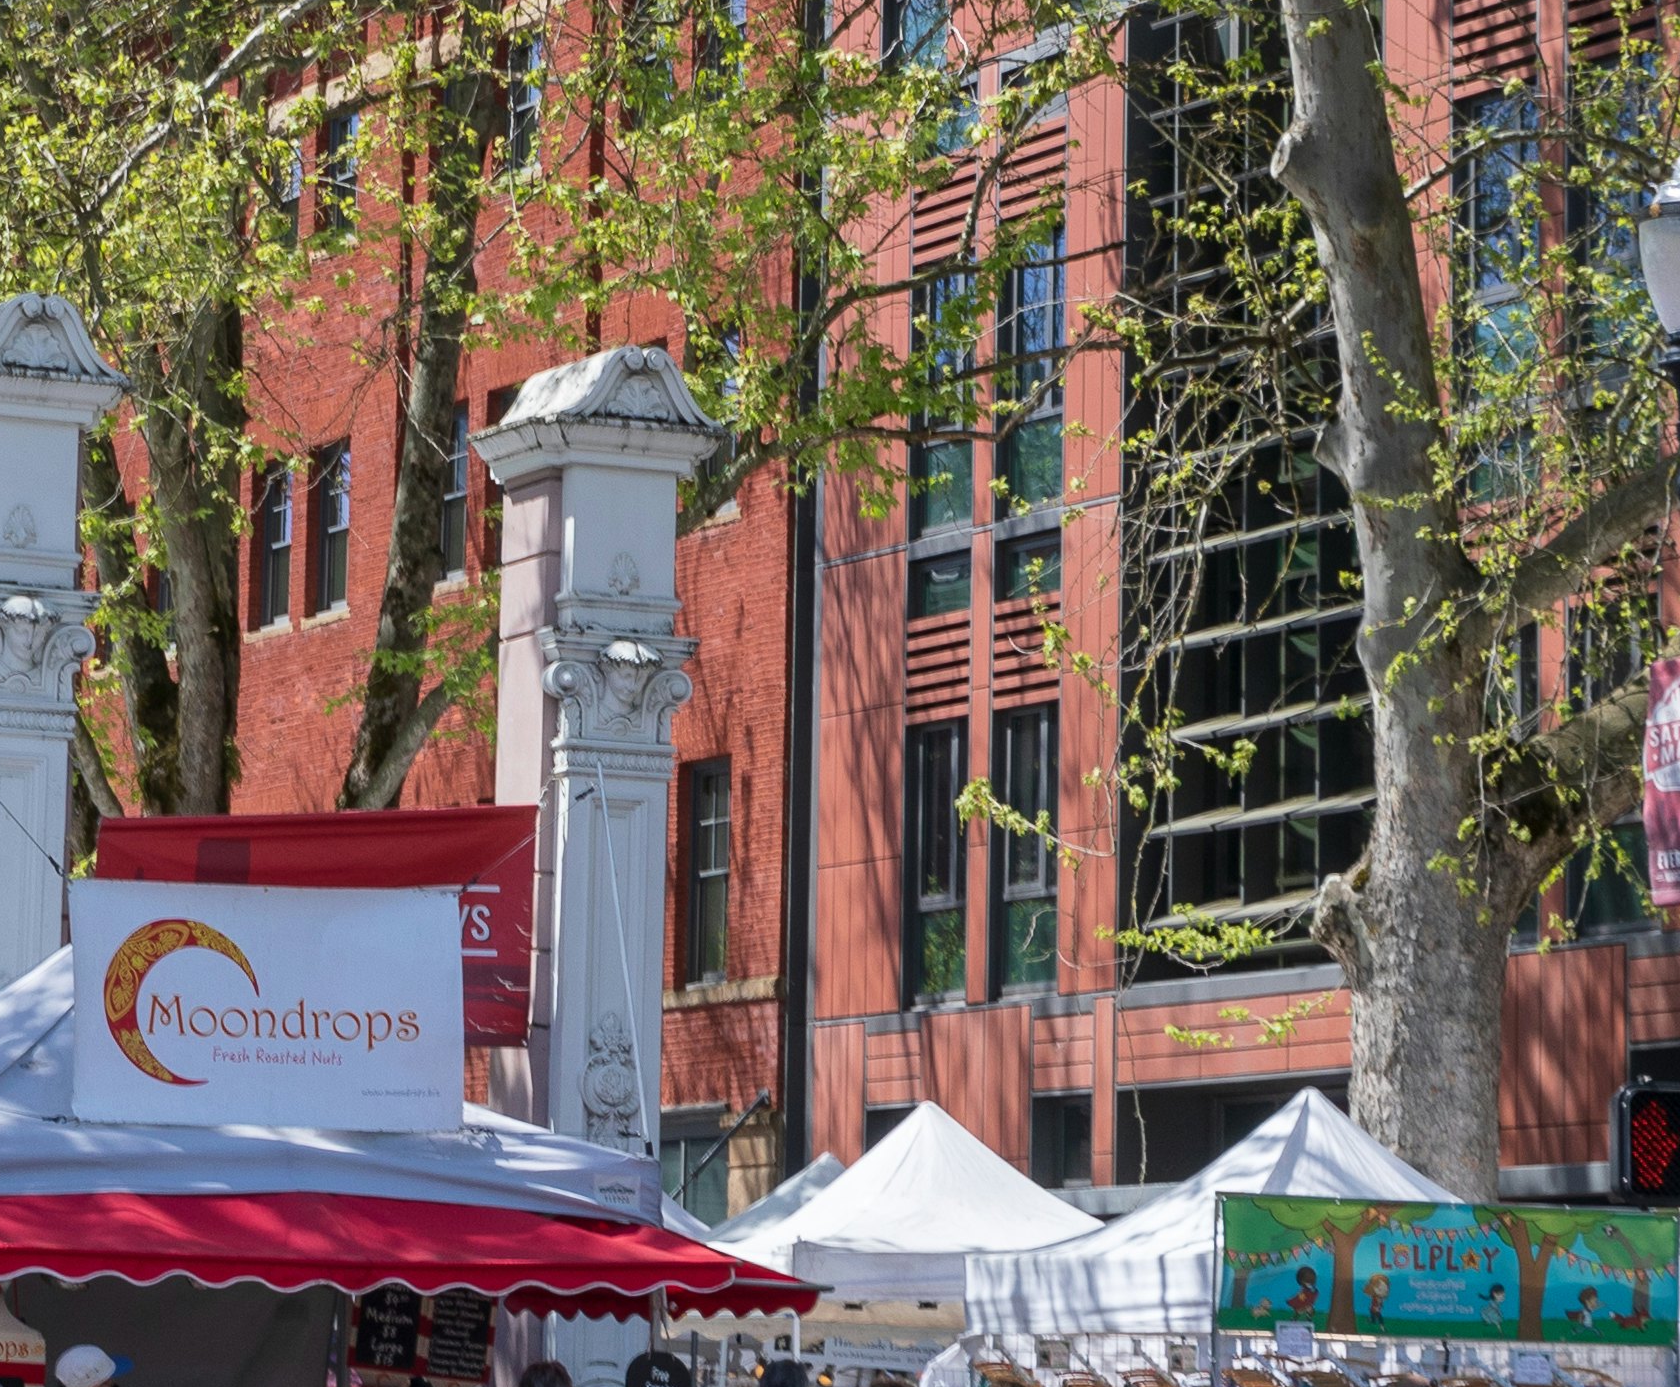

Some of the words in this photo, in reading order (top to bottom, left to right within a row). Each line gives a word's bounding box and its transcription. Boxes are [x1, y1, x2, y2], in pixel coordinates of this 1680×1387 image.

[147, 992, 421, 1053] Moondrops
[212, 1045, 251, 1063] Fresh
[255, 1047, 306, 1065] Roasted
[311, 1050, 343, 1066] Nuts
[1378, 1242, 1501, 1273] LOLPLAY
[651, 1365, 670, 1383] Free
